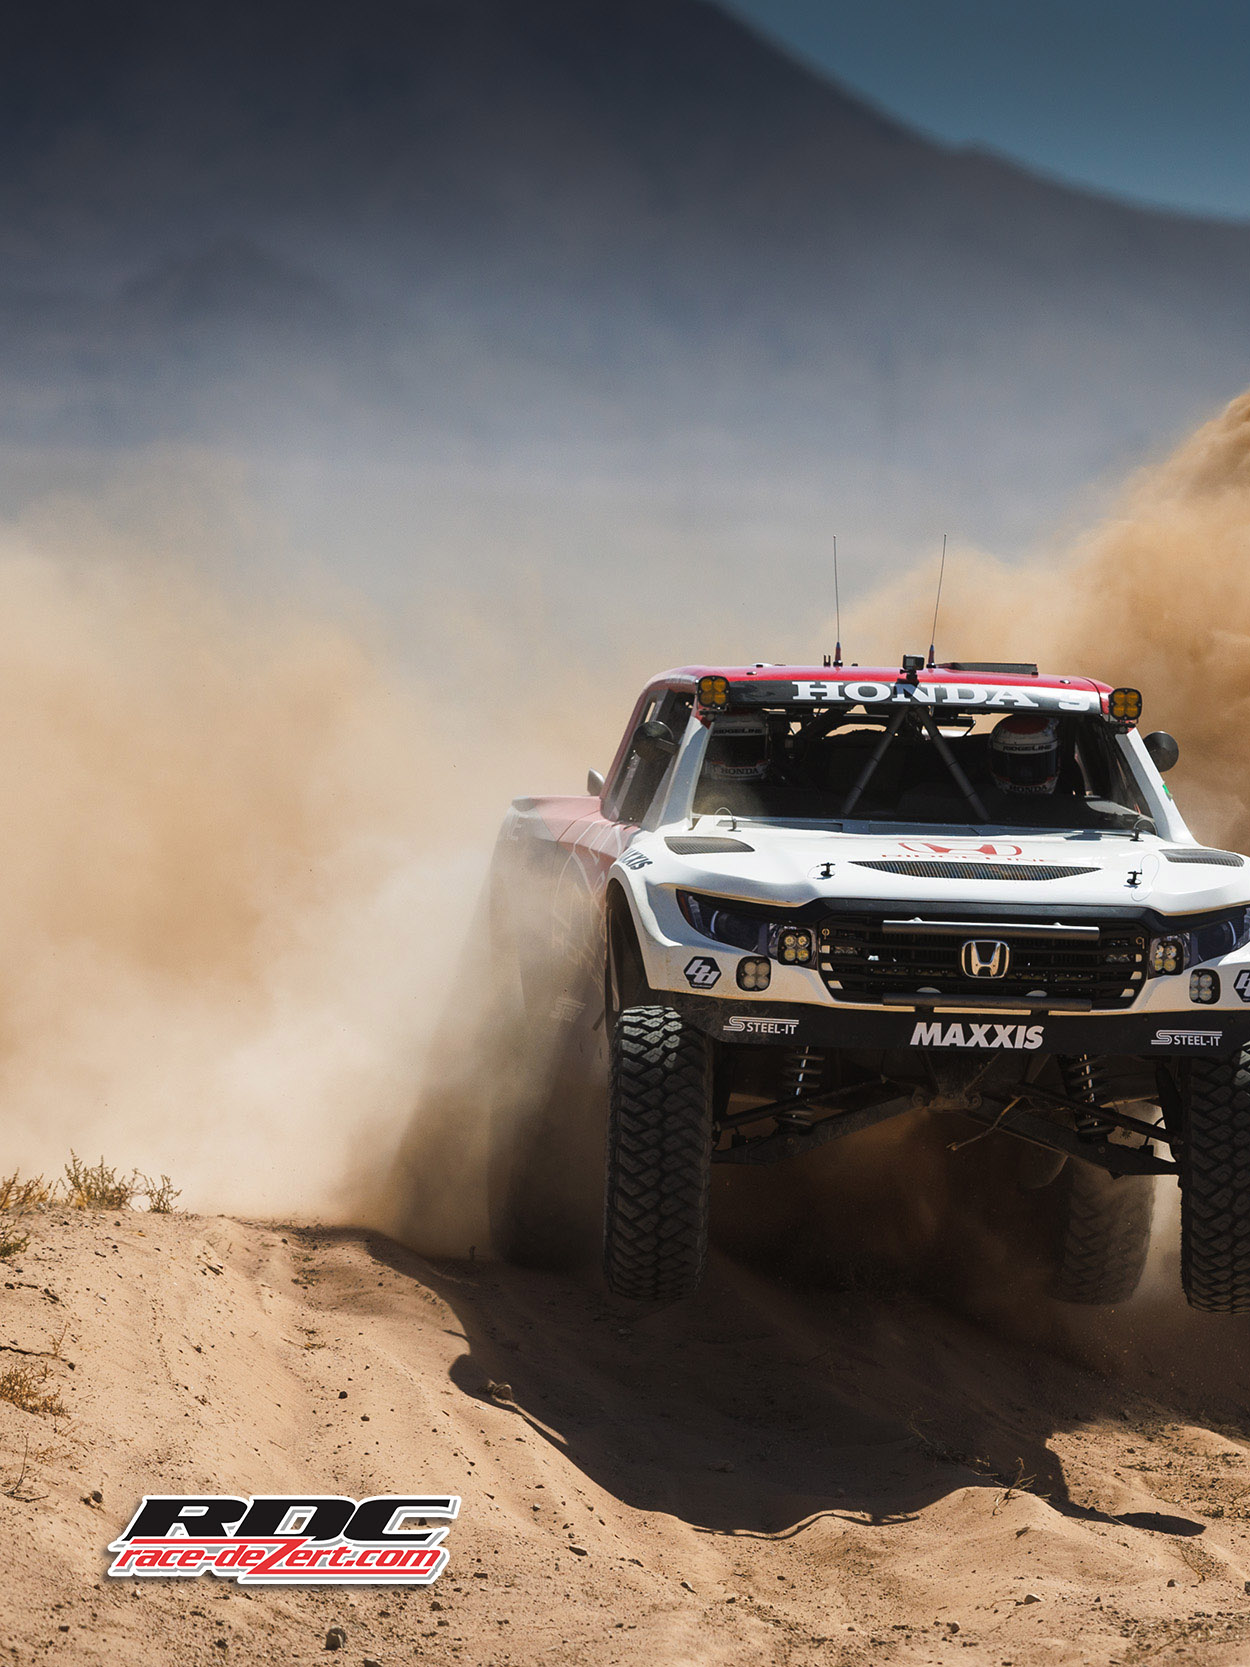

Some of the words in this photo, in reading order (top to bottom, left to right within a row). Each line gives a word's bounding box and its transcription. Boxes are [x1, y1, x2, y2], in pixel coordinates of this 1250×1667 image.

[791, 681, 1039, 708] HONDA
[720, 766, 760, 776] HONDA
[745, 1021, 798, 1036] STEEL-IT
[909, 1021, 1045, 1050] MAXXIS
[1173, 1034, 1221, 1047] STEEL-IT
